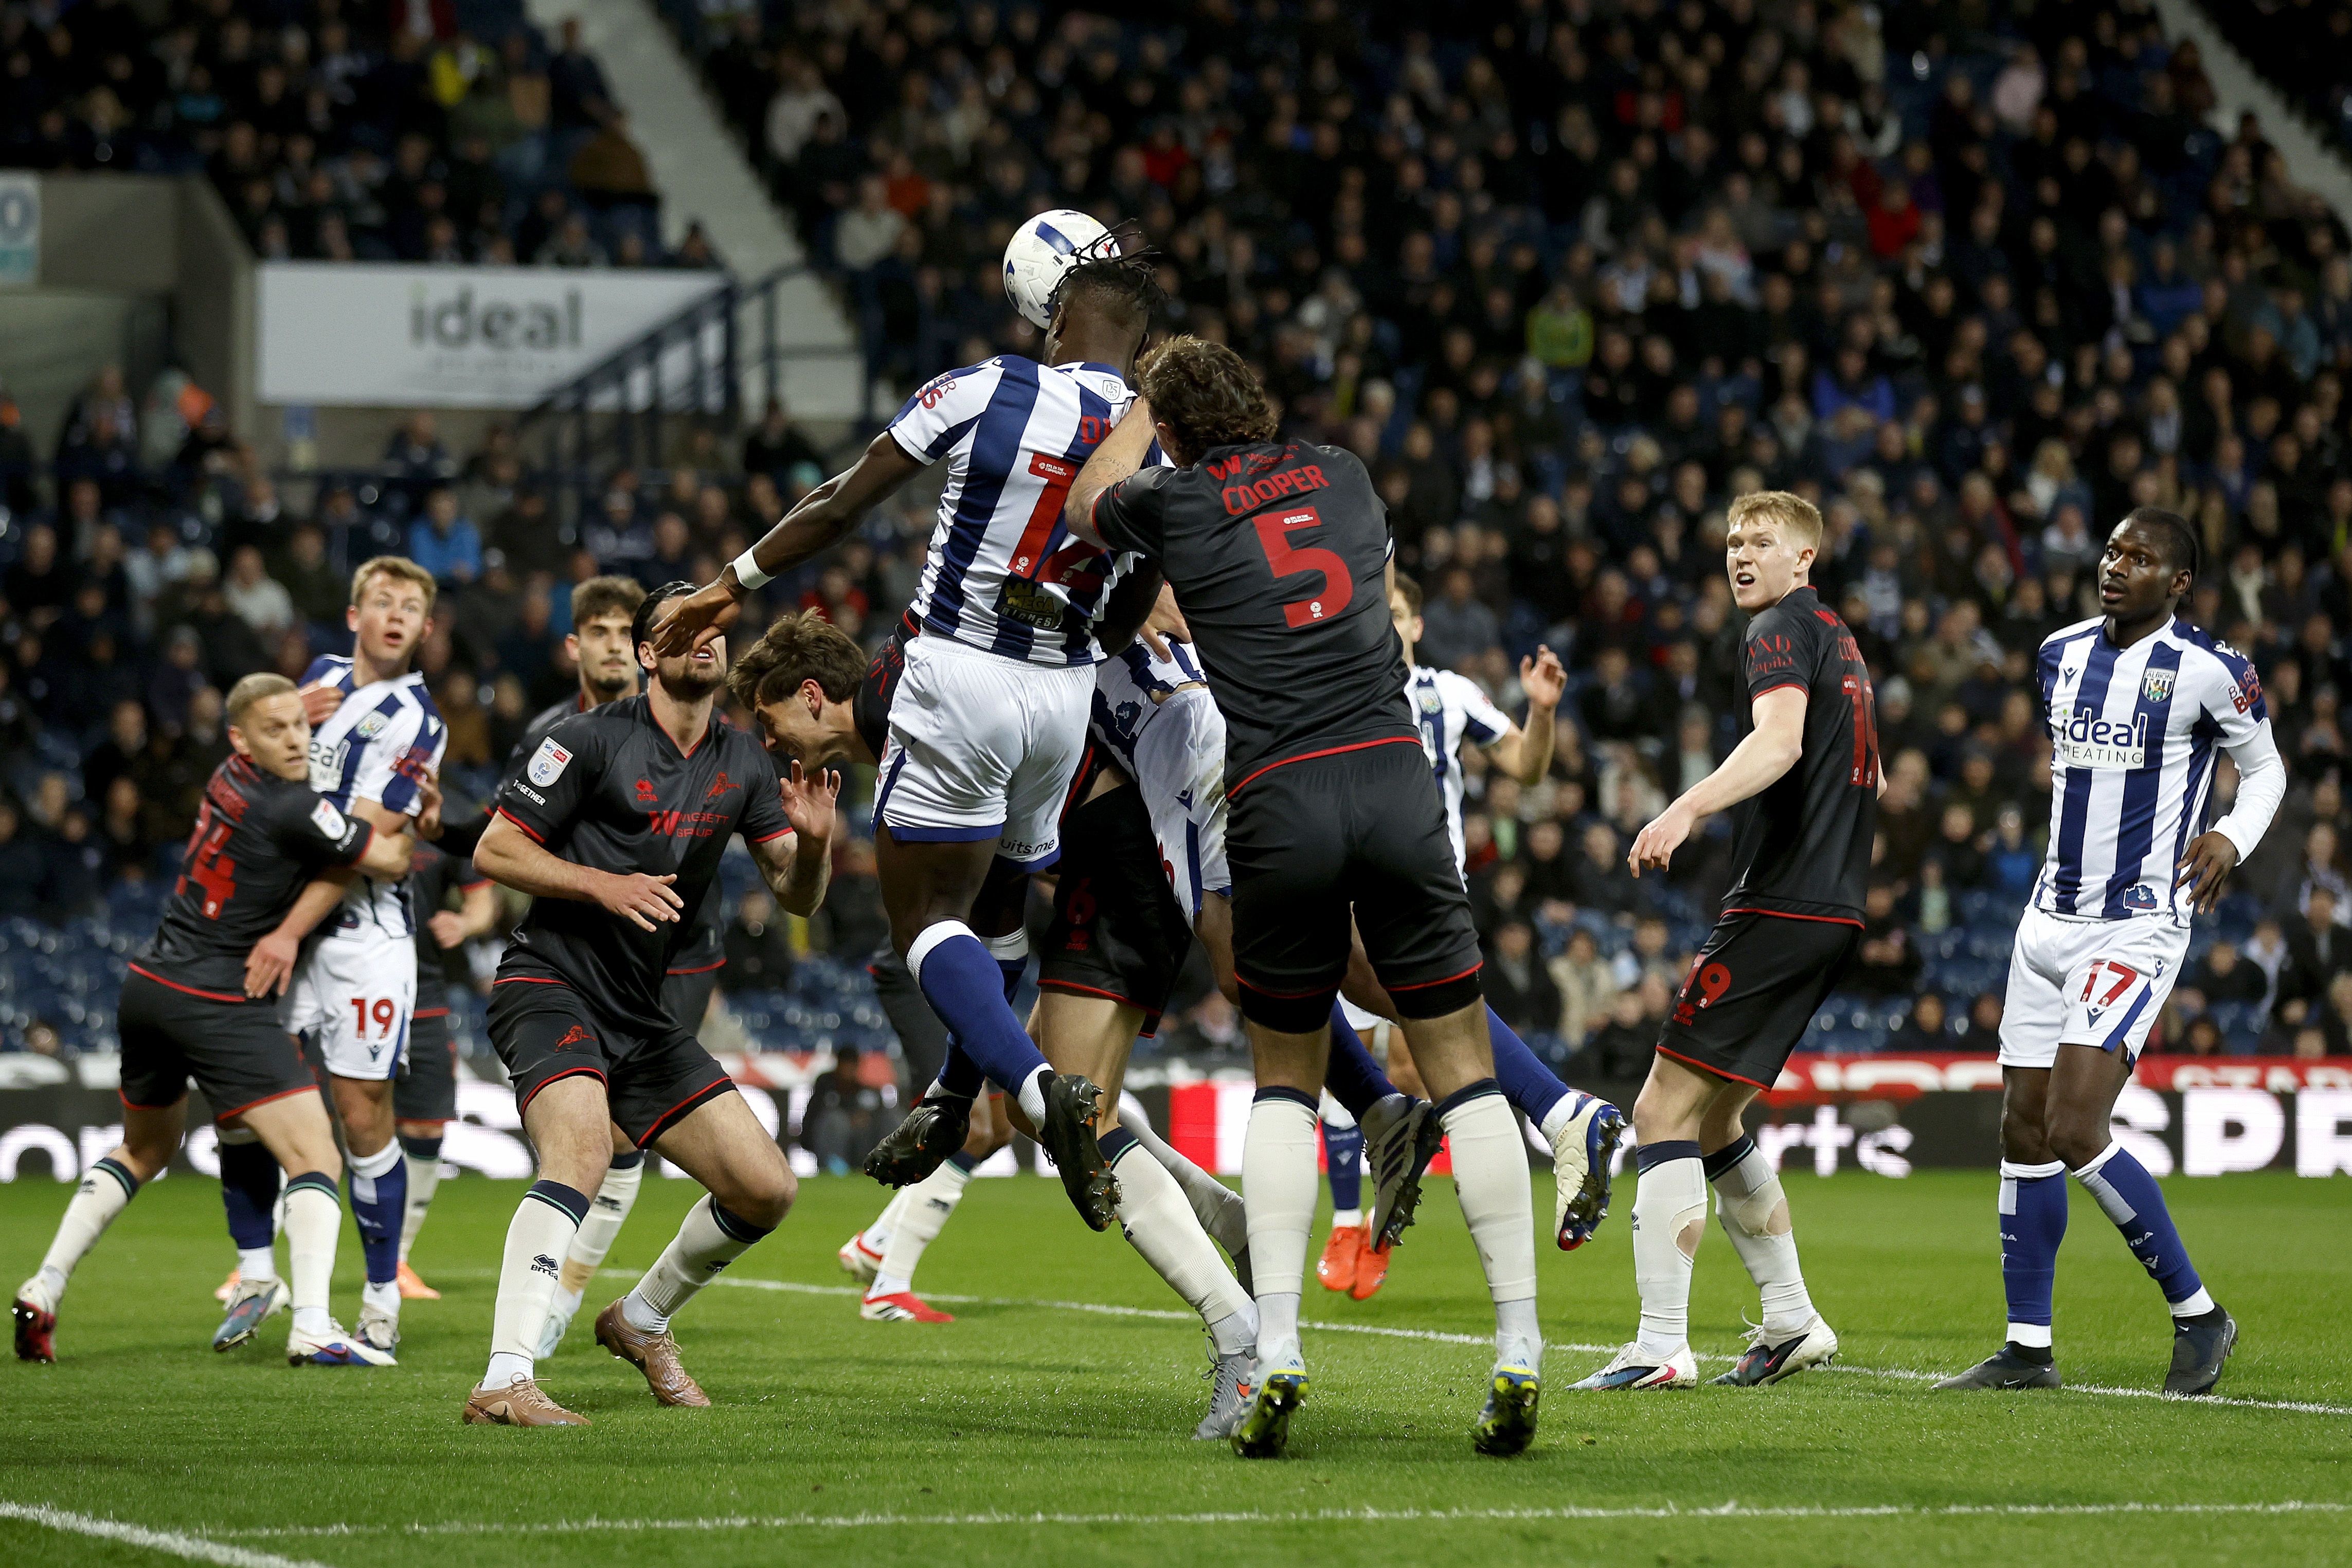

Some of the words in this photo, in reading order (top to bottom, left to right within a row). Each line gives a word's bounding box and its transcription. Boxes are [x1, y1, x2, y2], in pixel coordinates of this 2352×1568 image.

[410, 280, 582, 351] ideal
[1222, 465, 1330, 516] COOPER
[1015, 565, 1025, 573] EFL
[1252, 506, 1354, 628] 5
[1007, 596, 1055, 615] MEGA
[2233, 683, 2263, 715] BO
[2061, 709, 2146, 748] ideal
[544, 743, 555, 753] sky
[554, 750, 567, 762] bet
[2061, 744, 2143, 764] HEATING
[533, 772, 544, 782] EFL
[1679, 953, 1732, 1009] 19
[2079, 959, 2138, 1007] 17
[351, 998, 394, 1040] 19
